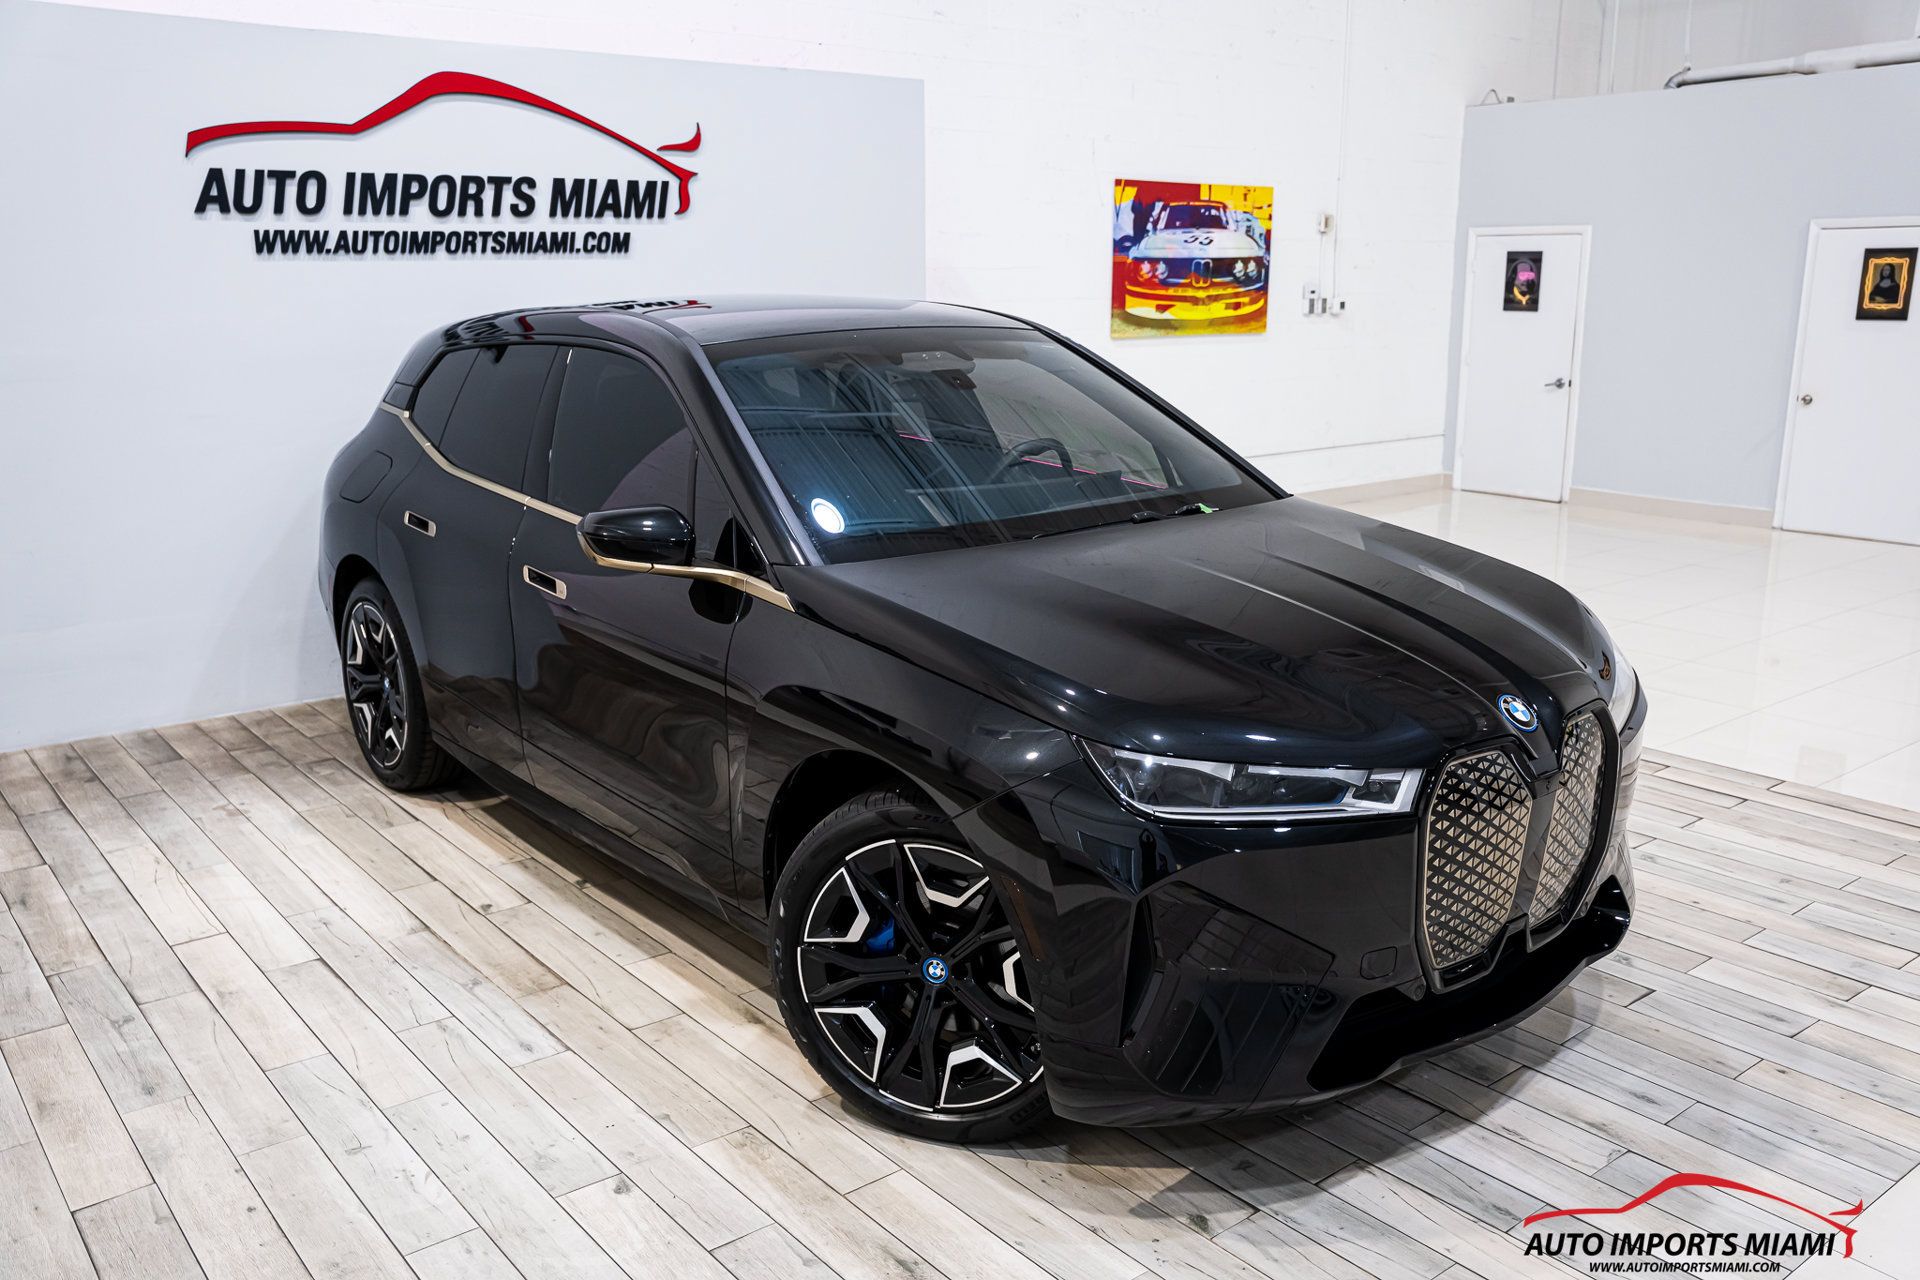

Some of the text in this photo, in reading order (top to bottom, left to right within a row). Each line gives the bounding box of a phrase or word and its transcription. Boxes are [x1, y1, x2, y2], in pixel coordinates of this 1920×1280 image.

[195, 167, 671, 220] AUTO IMPORTS MIAMI
[253, 229, 632, 256] WWW.AUTOIMPORTSMIAMI.COM
